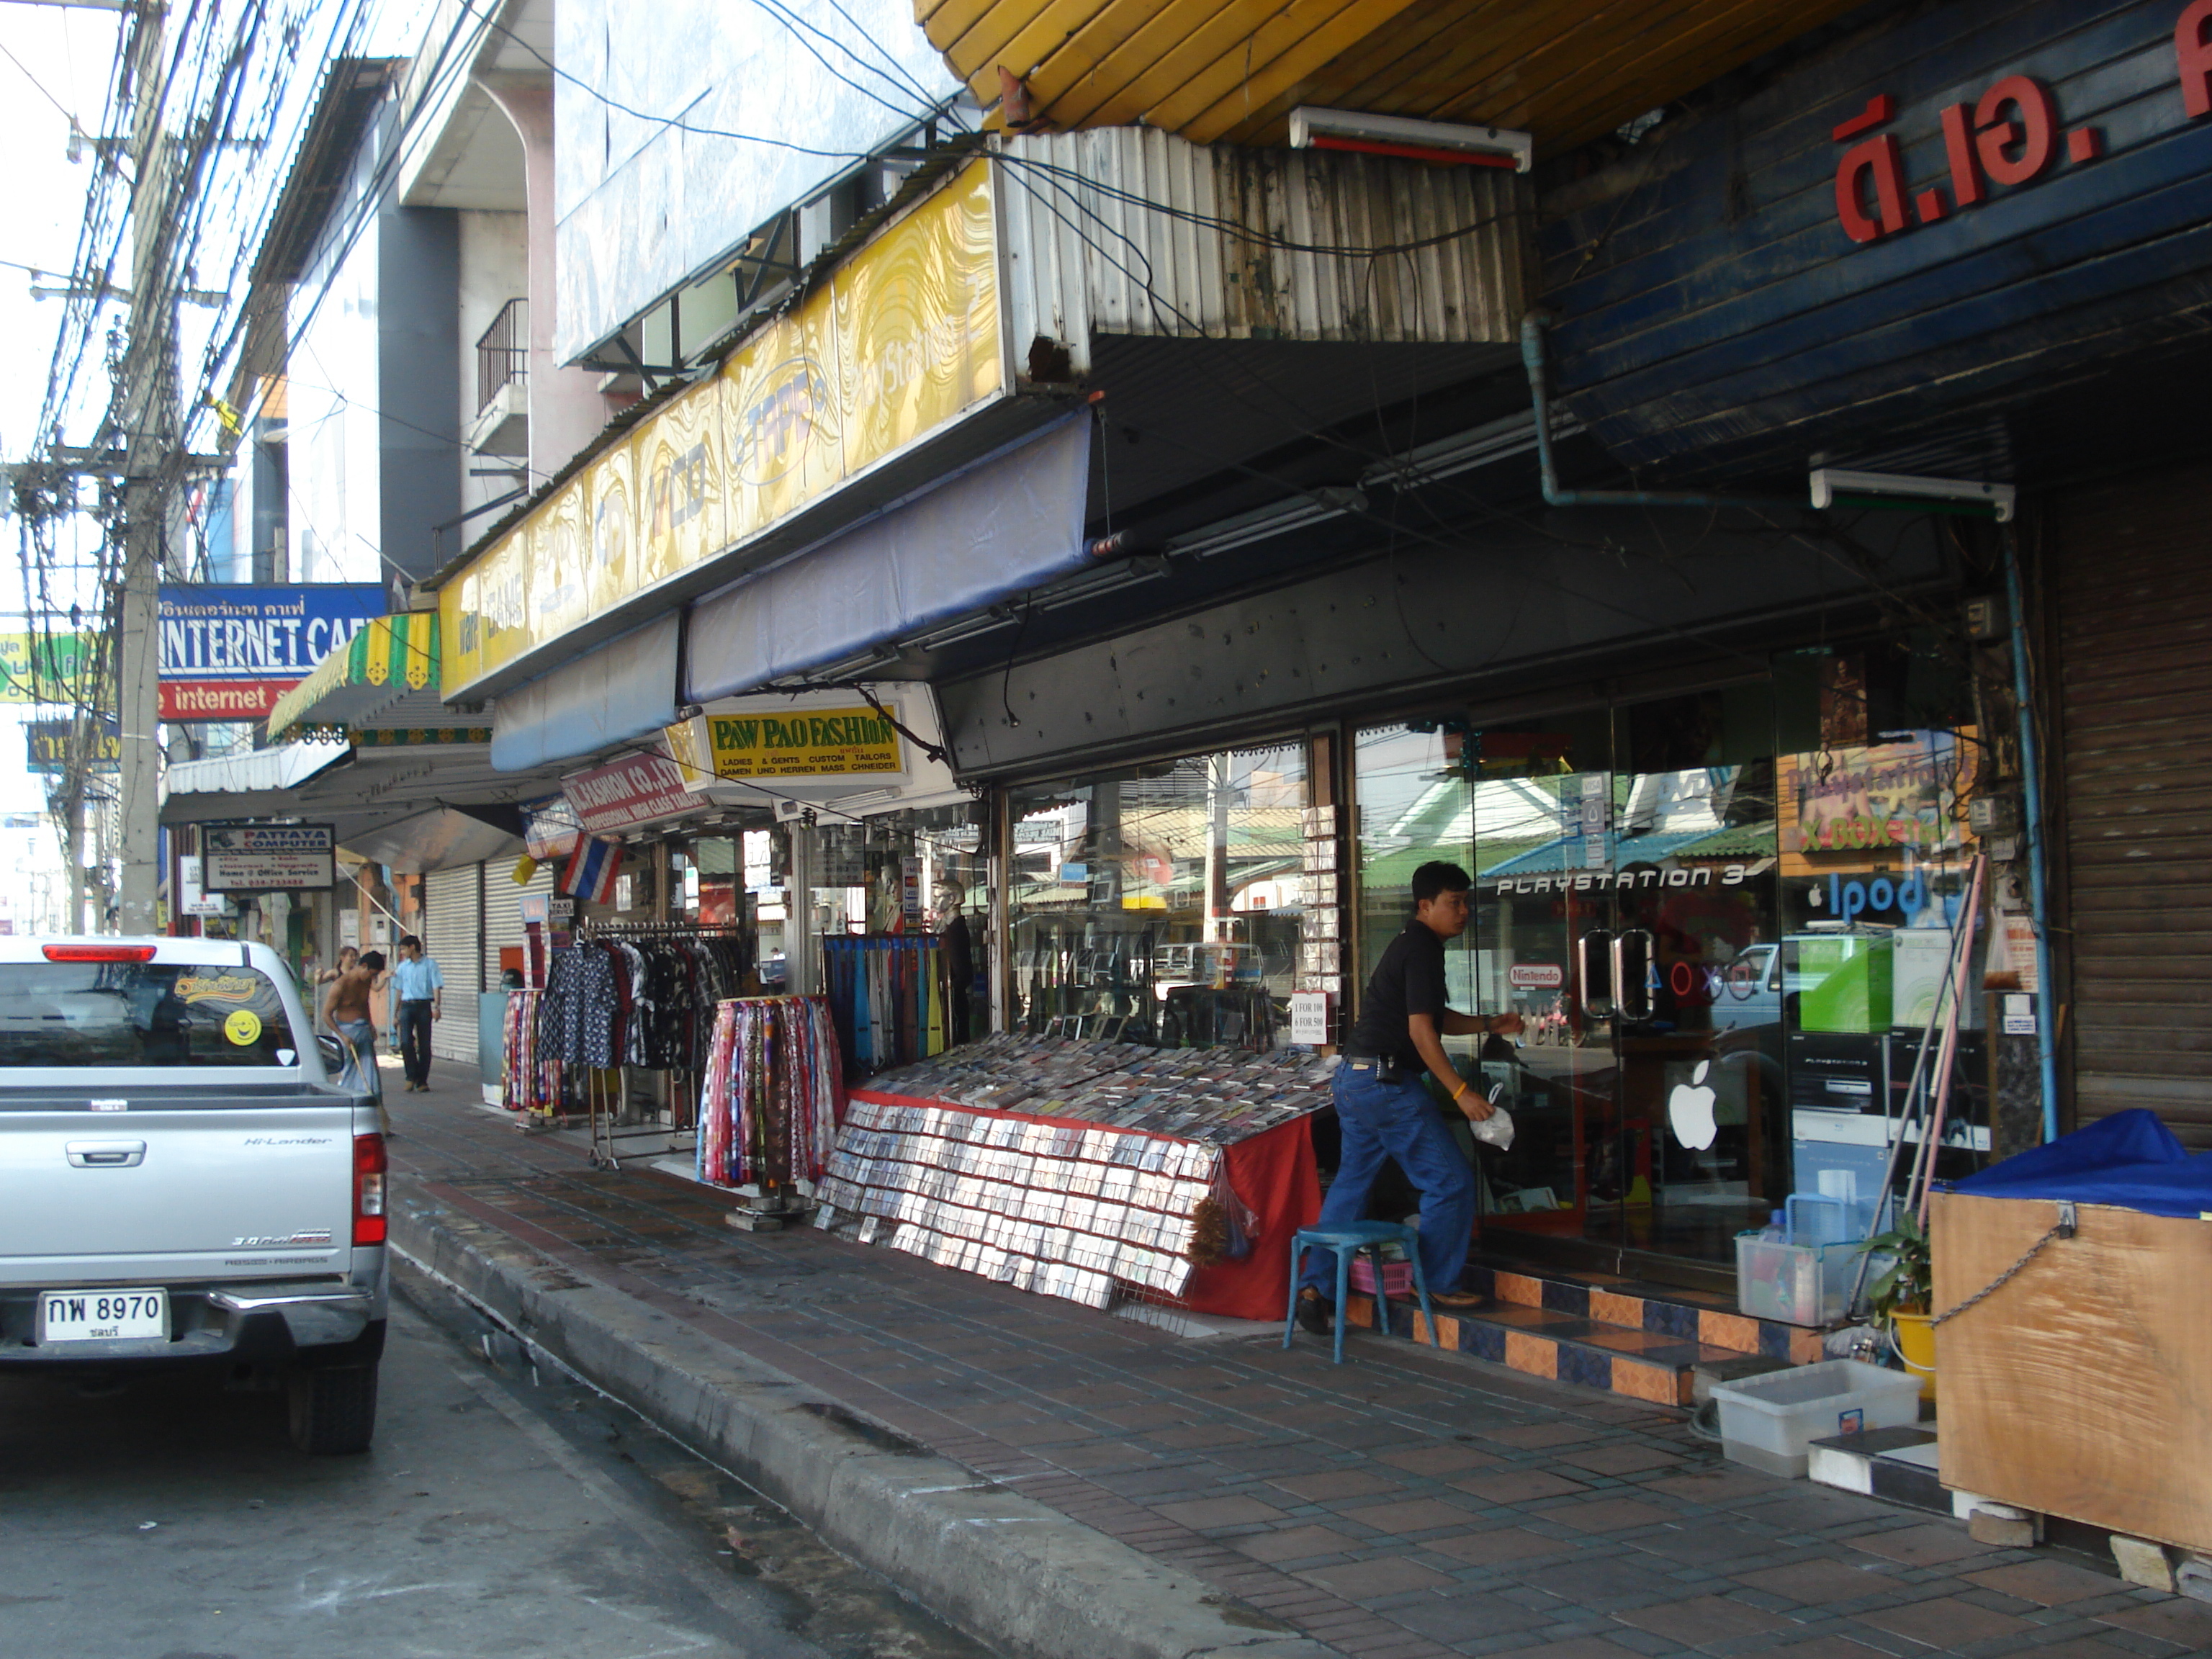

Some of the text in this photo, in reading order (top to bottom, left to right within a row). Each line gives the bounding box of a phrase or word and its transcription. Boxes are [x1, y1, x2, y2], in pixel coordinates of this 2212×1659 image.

[747, 370, 812, 469] TAPE
[649, 441, 706, 537] VCD
[595, 493, 626, 568] CD
[158, 617, 301, 667] INTERNET
[175, 685, 267, 710] internet
[809, 755, 845, 763] CUSTOM
[855, 752, 891, 761] TAILORS
[851, 762, 896, 770] CHNEIDER
[582, 806, 634, 832] PROFESSIONAL
[629, 801, 654, 821] HIGH
[649, 795, 675, 815] CLASS
[1497, 864, 1745, 896] PLAYSTATION 3
[1513, 969, 1559, 981] Nintendo
[1299, 1003, 1312, 1012] FOR
[1314, 1003, 1323, 1012] 100
[1300, 1017, 1313, 1027] FOR
[1313, 1017, 1323, 1027] 500
[97, 1297, 158, 1320] 8970
